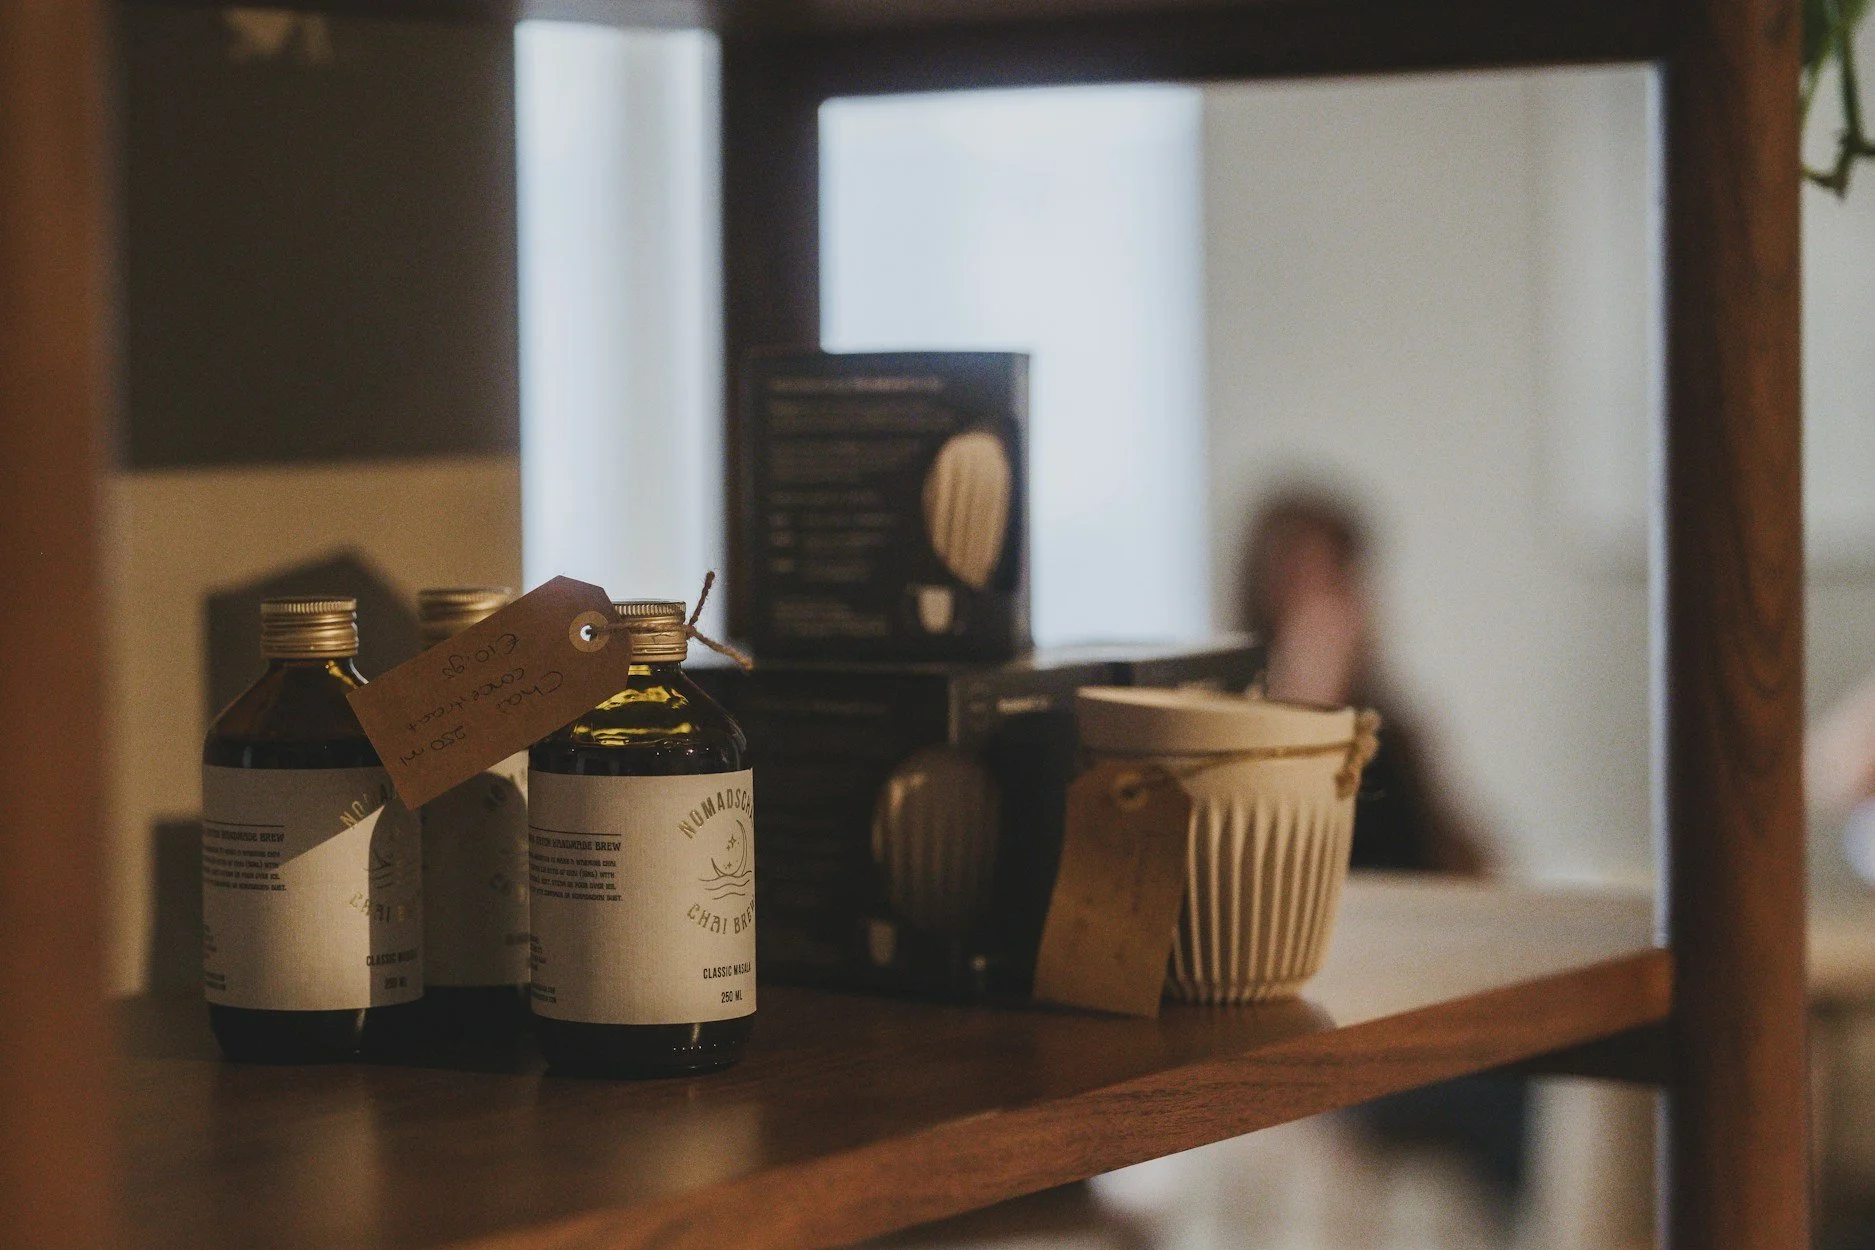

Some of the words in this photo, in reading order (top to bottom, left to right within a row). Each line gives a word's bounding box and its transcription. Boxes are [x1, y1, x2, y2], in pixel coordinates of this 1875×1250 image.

[497, 671, 564, 714] Chai
[431, 725, 466, 750] 250
[595, 841, 621, 851] BREW
[687, 903, 727, 935] CHAI
[703, 964, 732, 980] CLASSIC
[733, 961, 751, 977] MASALA
[721, 990, 733, 1003] 250
[734, 989, 743, 1002] ML
